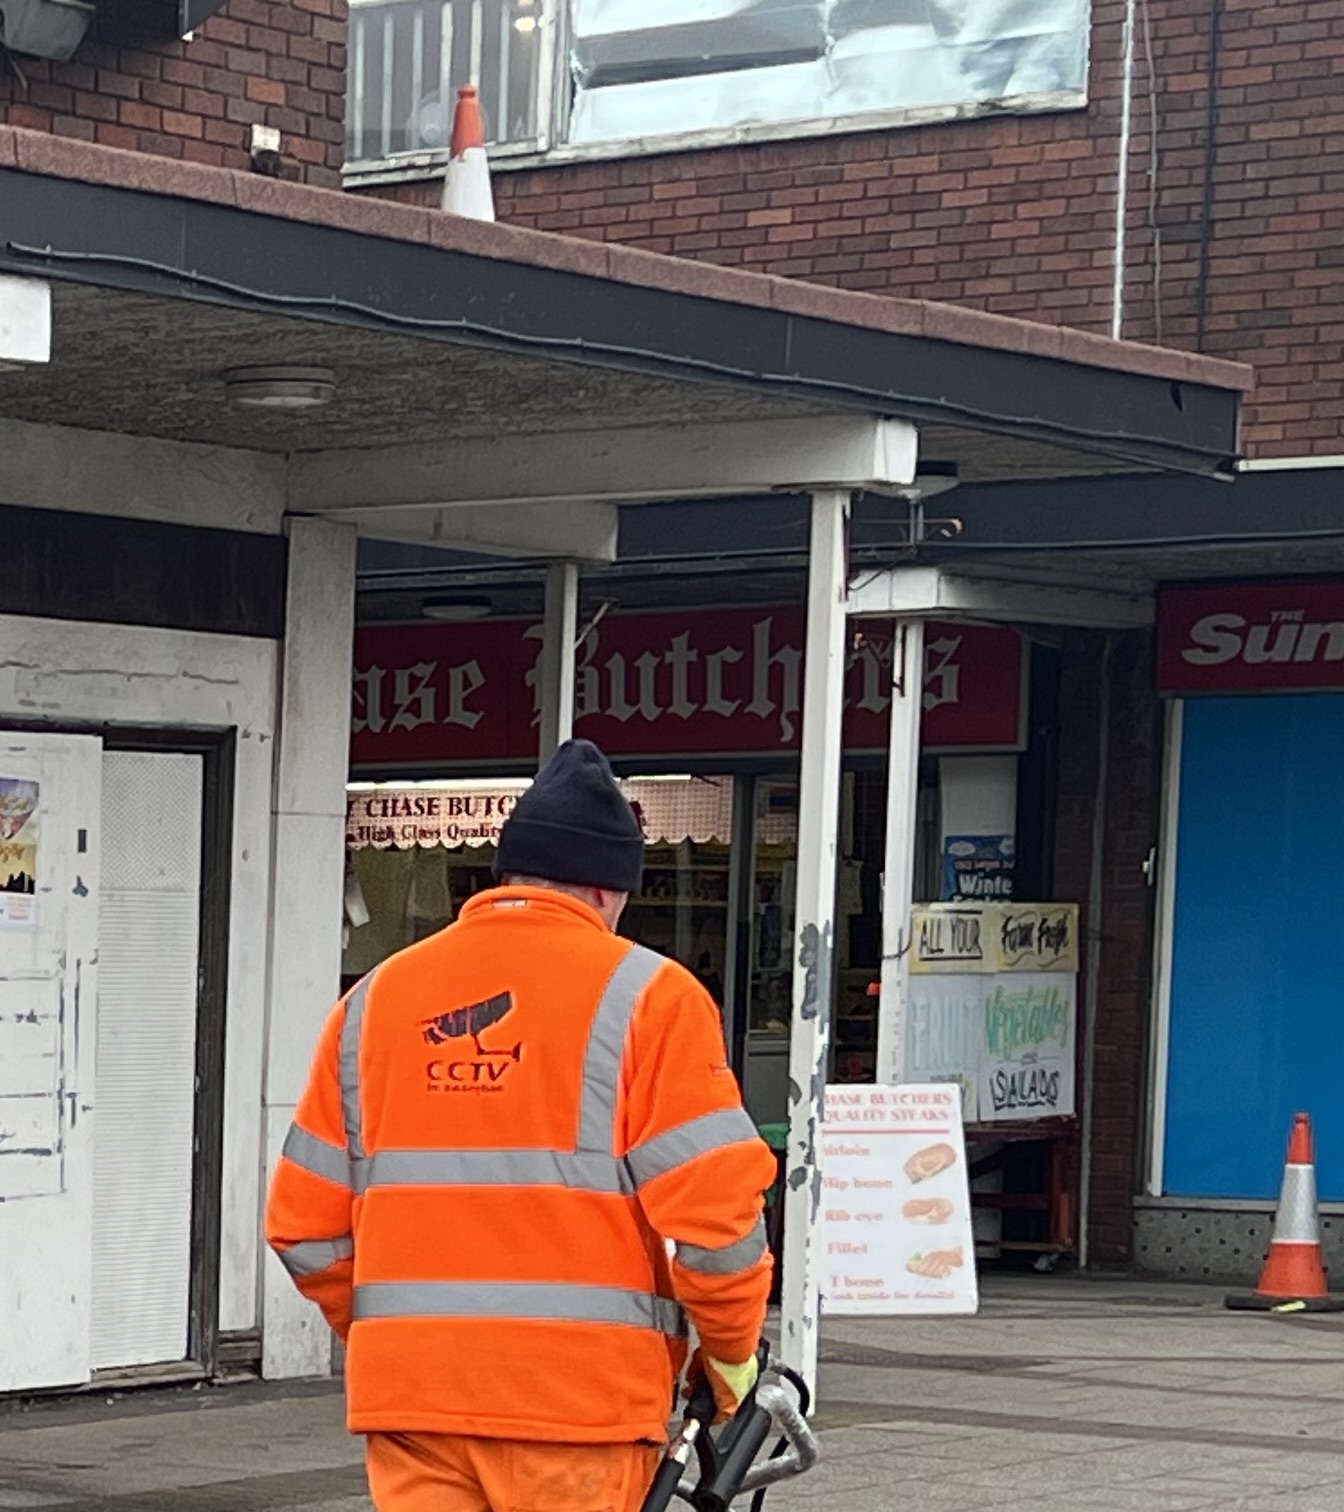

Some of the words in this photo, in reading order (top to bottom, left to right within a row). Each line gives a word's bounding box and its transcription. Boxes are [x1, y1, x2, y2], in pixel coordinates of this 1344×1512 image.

[1181, 612, 1344, 665] Sun
[352, 659, 486, 733] ase
[522, 617, 962, 742] Butchrs
[366, 796, 442, 818] CHASE
[448, 795, 518, 817] BUTC
[401, 823, 442, 840] Class
[958, 872, 1014, 896] Winte
[920, 918, 947, 955] ALL
[950, 917, 984, 956] YOUR
[427, 1060, 509, 1082] CCTV
[990, 1069, 1060, 1104] SALADS
[824, 1093, 863, 1105] HASE
[870, 1093, 953, 1105] BUTCHERS
[890, 1109, 949, 1122] STEAKS
